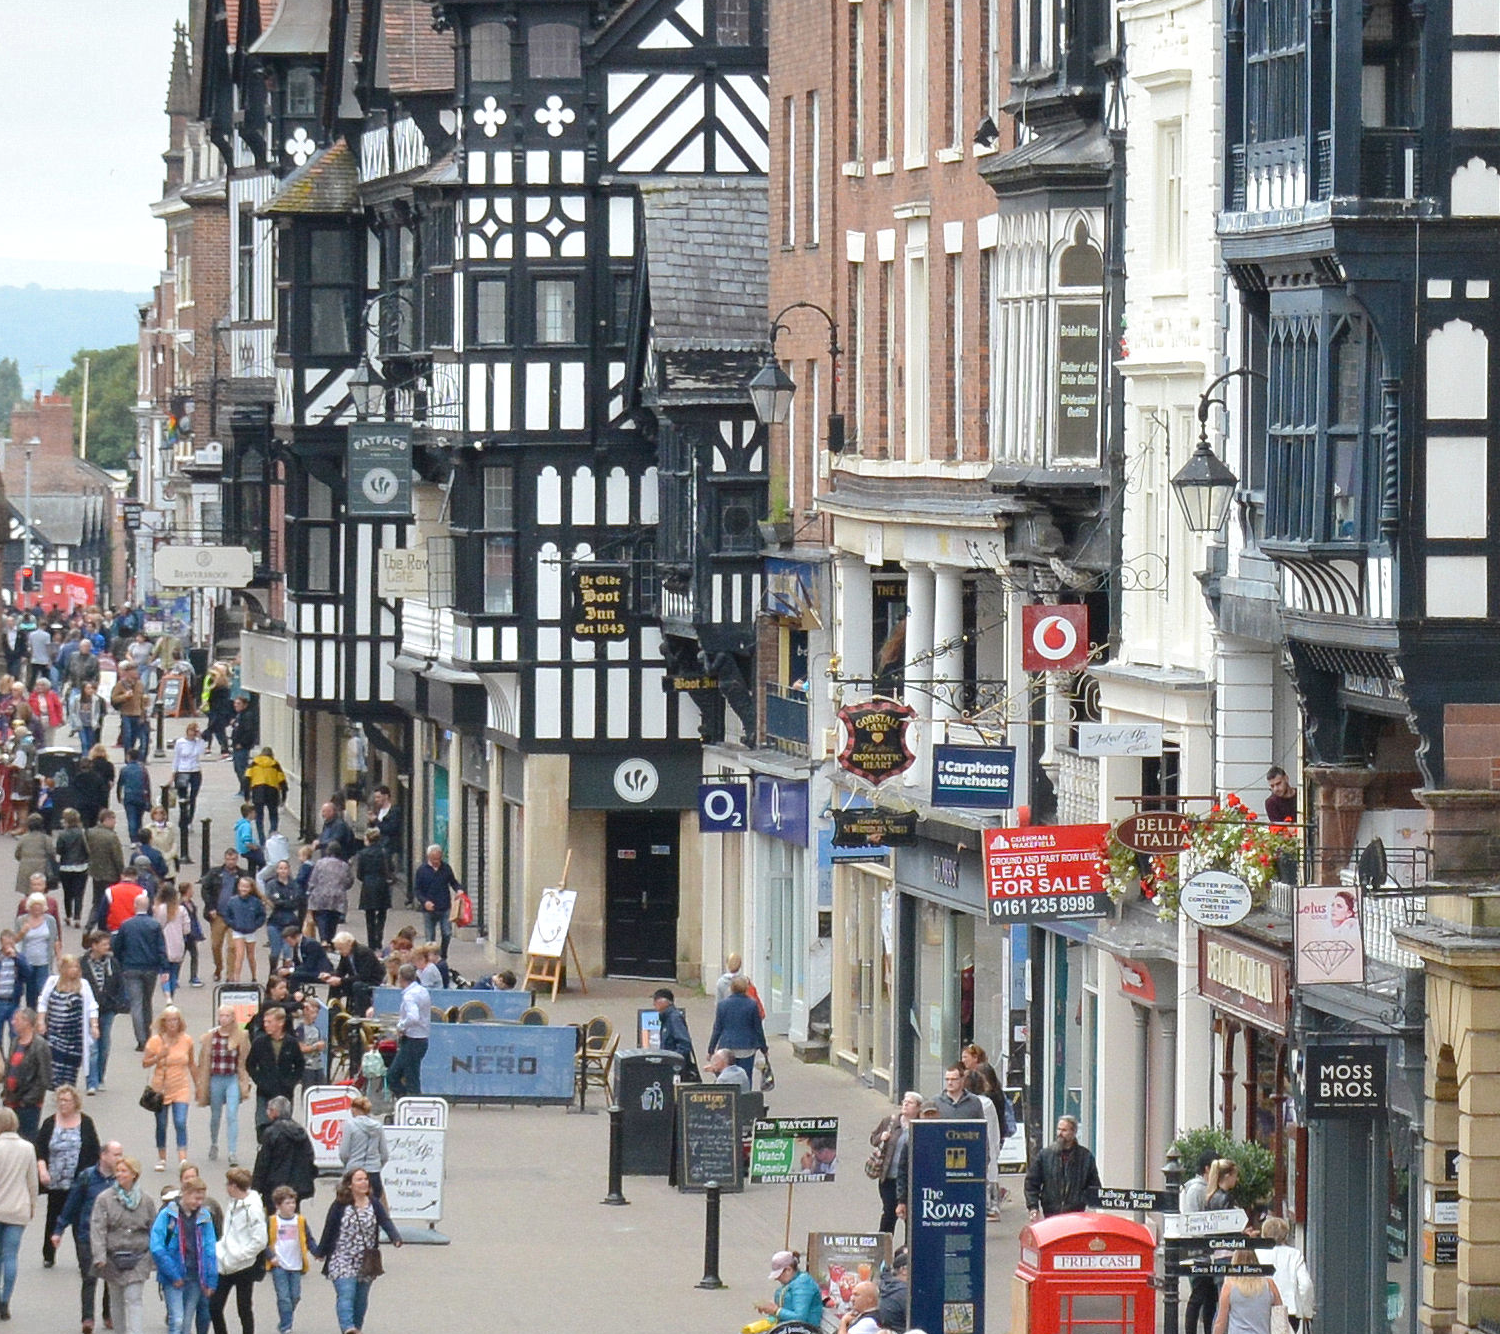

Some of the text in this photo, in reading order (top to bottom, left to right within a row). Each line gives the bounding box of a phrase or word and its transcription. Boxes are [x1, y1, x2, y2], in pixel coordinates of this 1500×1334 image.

[353, 435, 408, 451] FATFACE
[596, 575, 621, 585] Olde
[582, 589, 620, 605] Boot
[585, 607, 616, 621] Inn
[575, 623, 626, 634] Est 1643
[852, 753, 902, 762] ROMANTIC
[863, 761, 893, 769] HEART
[945, 761, 1009, 777] Carphone
[938, 773, 1008, 788] Warehouse
[704, 789, 742, 827] O2
[1136, 819, 1189, 831] BELLA
[1134, 833, 1190, 847] ITALIA
[990, 855, 1022, 866] GROUND
[1024, 855, 1040, 864] AND
[1040, 853, 1060, 863] PART
[1062, 853, 1080, 862] ROW
[991, 863, 1048, 879] LEASE
[992, 875, 1092, 896] FOR SALE
[993, 895, 1095, 917] 0161 235 8998
[1297, 898, 1327, 914] Lotus
[452, 1055, 537, 1075] NERO
[1320, 1065, 1373, 1079] MOSS
[1320, 1082, 1378, 1098] BROS.
[407, 1117, 437, 1127] CAFE
[756, 1119, 836, 1131] The WATCH Lab
[756, 1139, 788, 1151] Quality
[758, 1151, 786, 1161] Watch
[754, 1162, 788, 1174] Repairs
[762, 1173, 826, 1183] EASTGATE STREET
[922, 1187, 944, 1200] The
[1098, 1189, 1156, 1201] Railway Station
[922, 1199, 975, 1220] Rows
[1102, 1199, 1152, 1210] via City Road
[824, 1235, 834, 1245] LA
[1208, 1239, 1246, 1249] Cathedral
[1062, 1255, 1134, 1267] FREE CASH
[1190, 1266, 1209, 1274] Town
[1210, 1266, 1226, 1274] Hall
